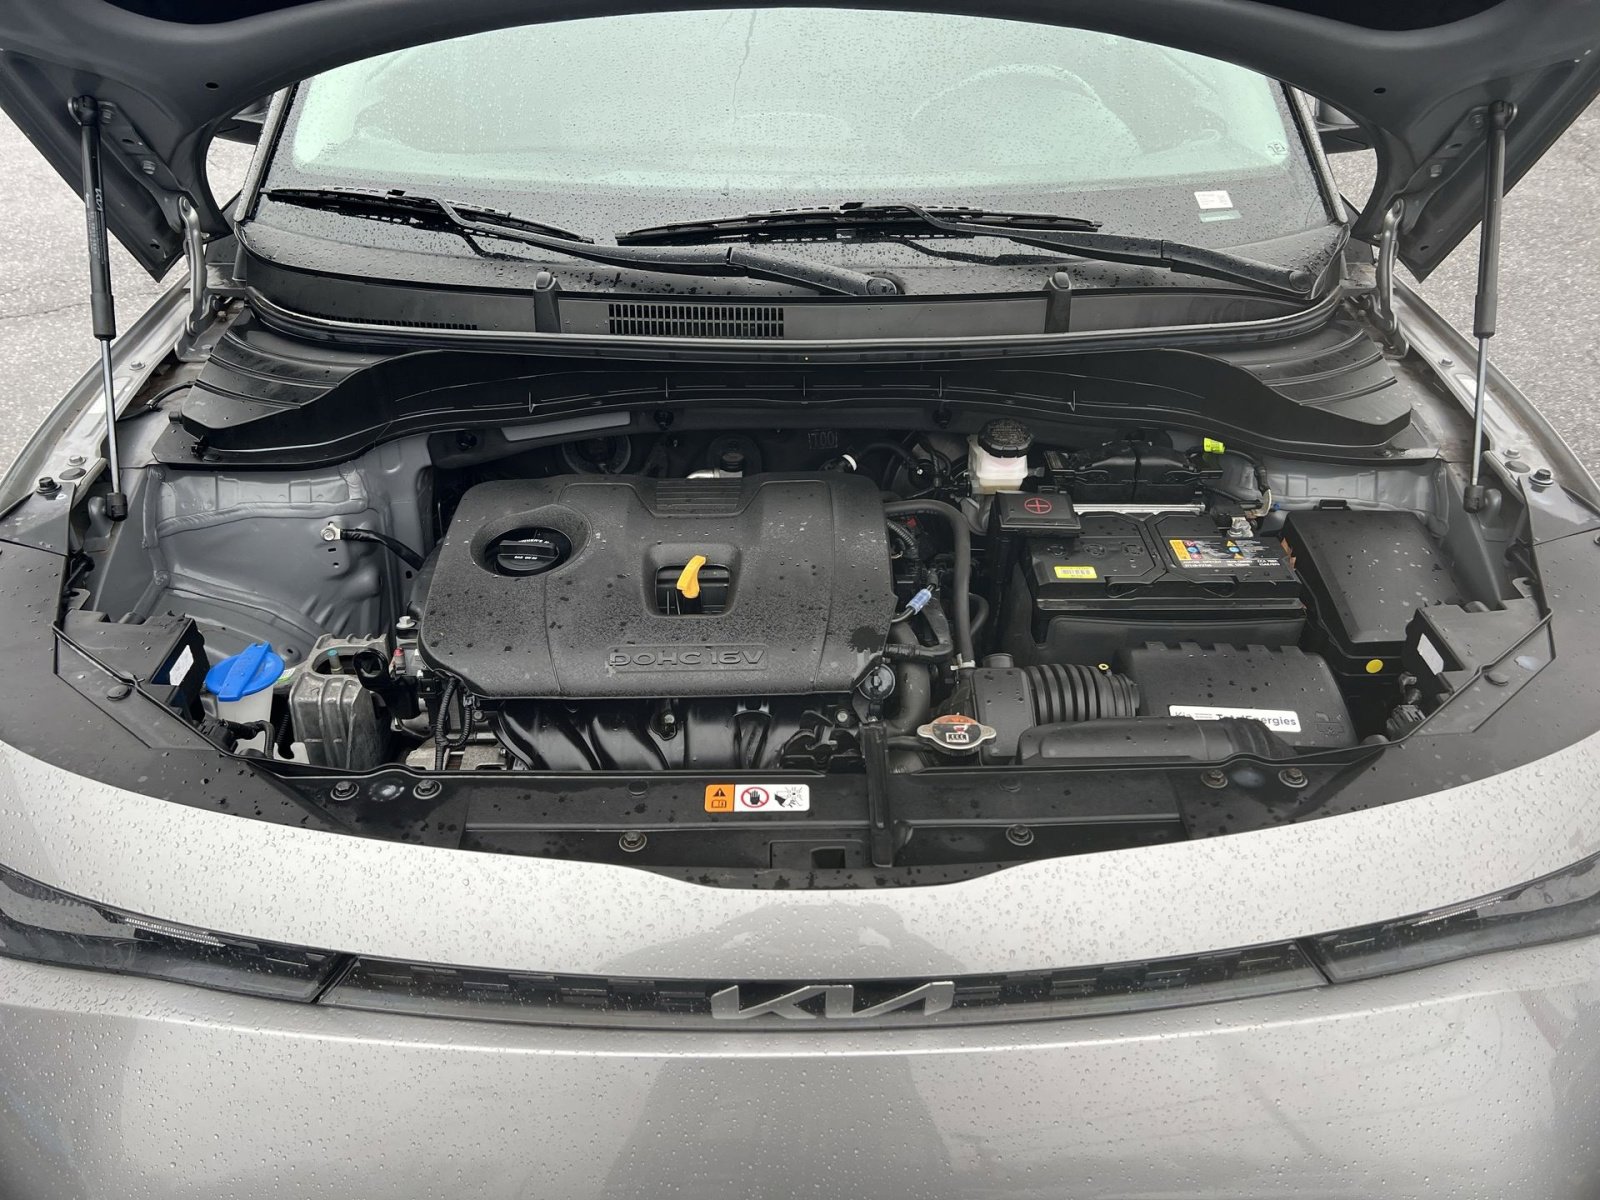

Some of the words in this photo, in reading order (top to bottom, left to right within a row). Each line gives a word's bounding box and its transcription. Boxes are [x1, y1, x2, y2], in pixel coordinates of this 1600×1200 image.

[609, 651, 701, 667] DOHC
[710, 650, 765, 665] 16V
[711, 981, 955, 1019] KIA
